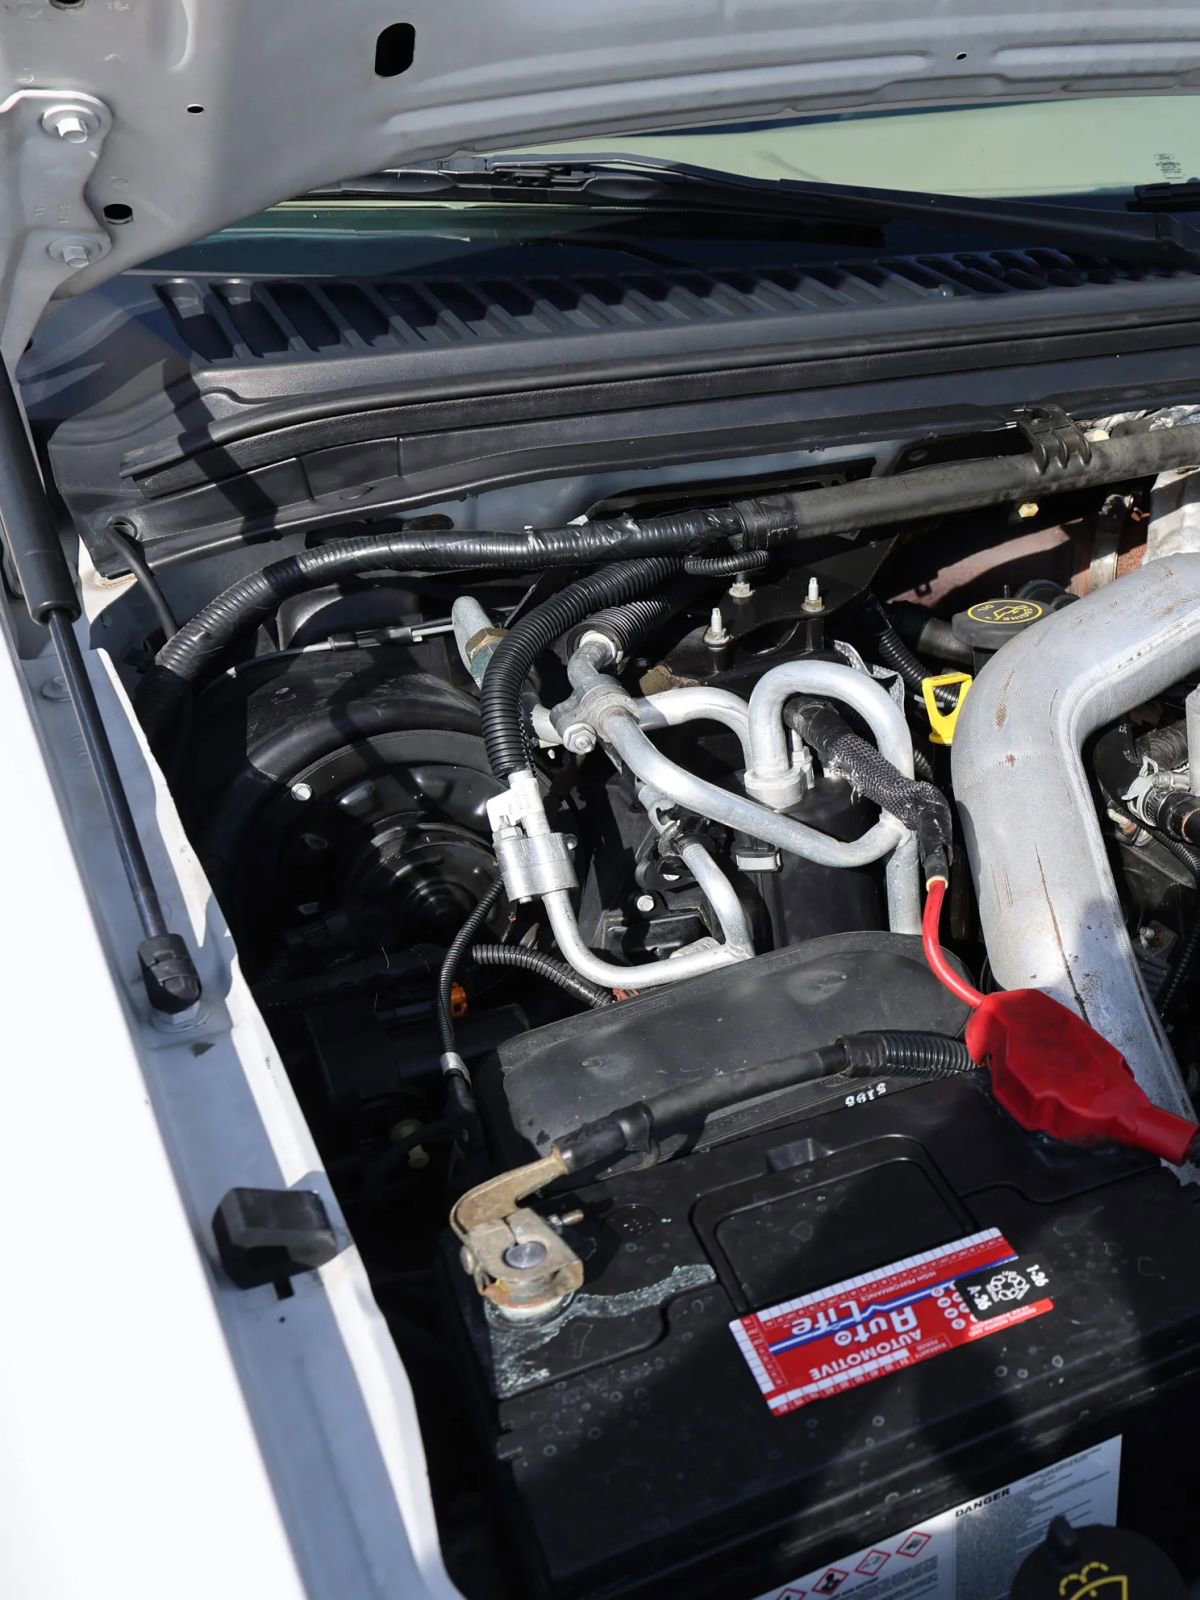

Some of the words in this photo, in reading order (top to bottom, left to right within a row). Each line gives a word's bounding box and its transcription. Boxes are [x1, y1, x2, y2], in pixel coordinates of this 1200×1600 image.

[791, 1299, 862, 1336] Life
[833, 1305, 919, 1347] Auto
[810, 1329, 921, 1381] AUTOMOTIVE
[955, 1487, 1010, 1518] DANGER
